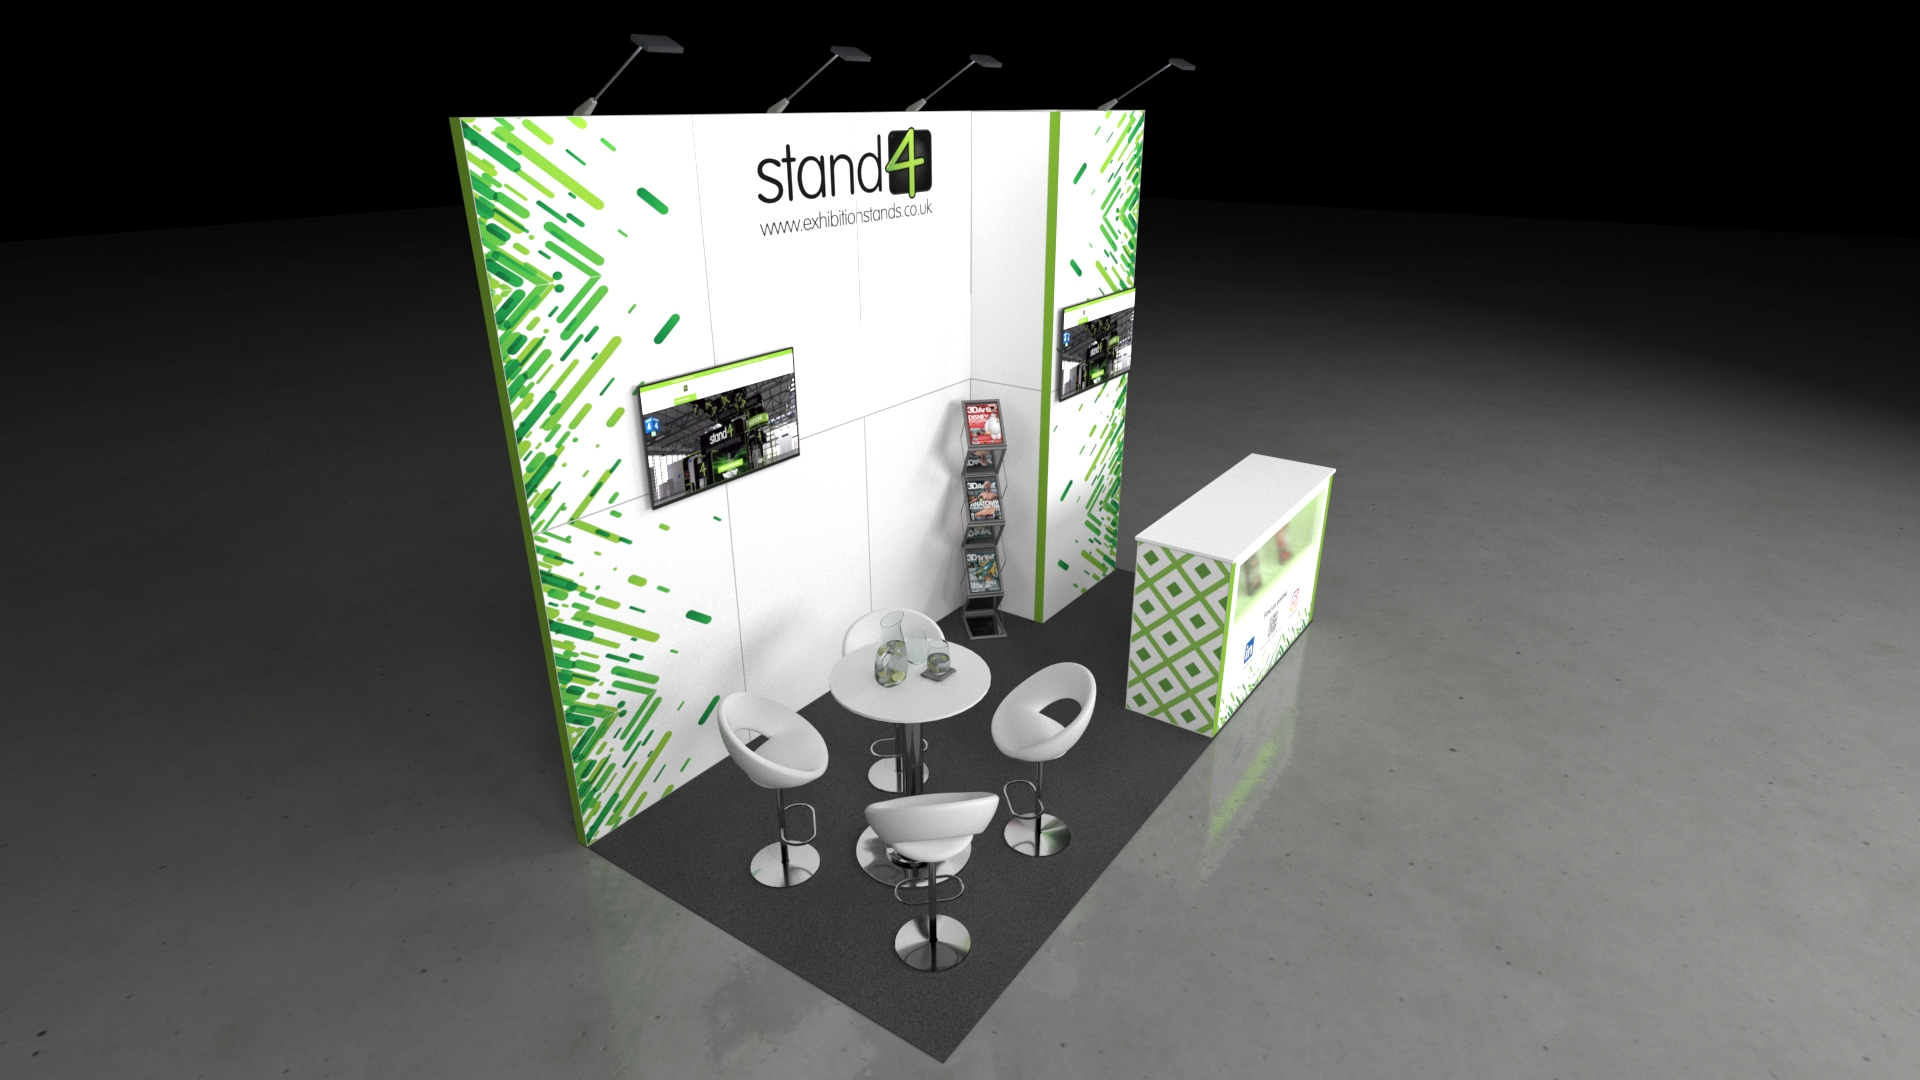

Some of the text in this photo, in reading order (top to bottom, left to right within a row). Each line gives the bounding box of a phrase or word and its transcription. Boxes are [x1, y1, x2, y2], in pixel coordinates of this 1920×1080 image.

[757, 127, 926, 203] stand4
[760, 198, 932, 236] www.exhibitionstands.co.uk
[967, 406, 997, 414] 3DArtit
[709, 423, 734, 445] stand4
